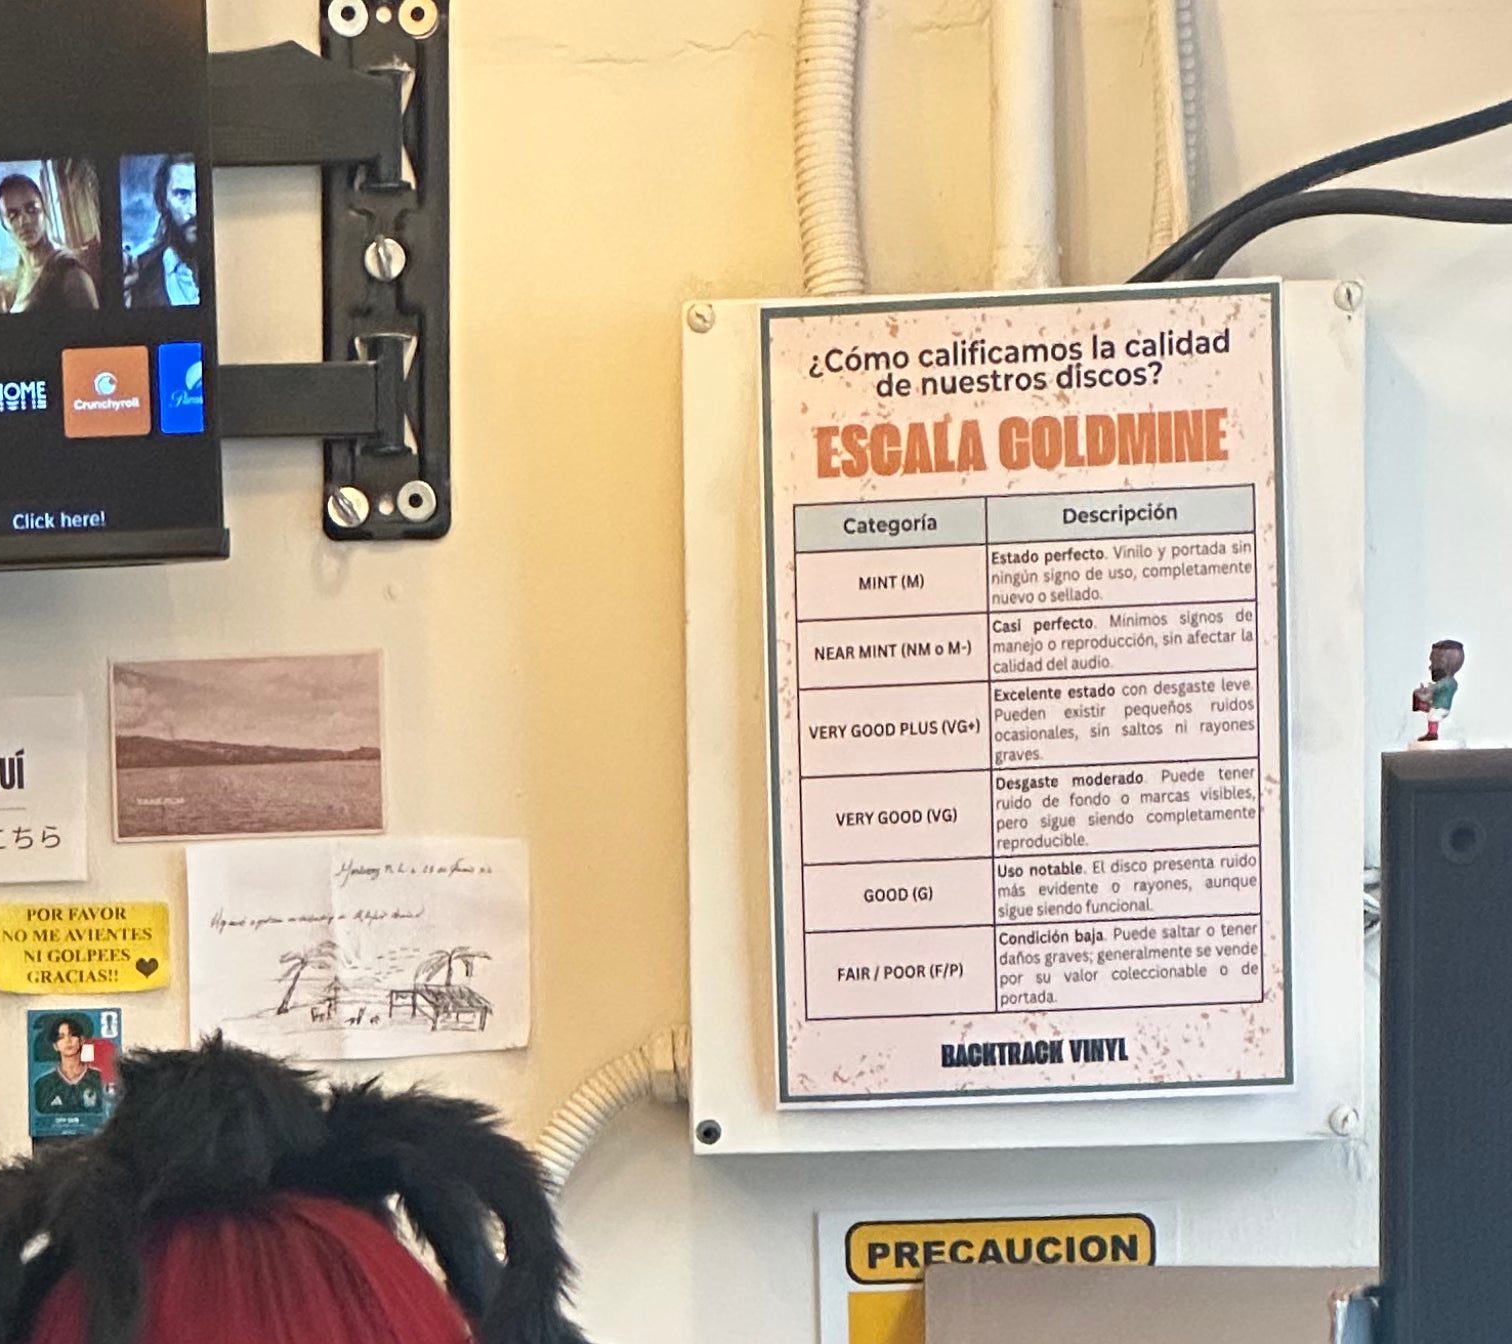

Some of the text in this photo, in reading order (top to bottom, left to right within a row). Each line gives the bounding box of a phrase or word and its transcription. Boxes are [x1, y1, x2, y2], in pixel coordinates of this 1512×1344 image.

[809, 328, 1231, 379] ¿Cómo calificamos la calidad
[876, 361, 1163, 398] de nuestros discos?
[74, 398, 139, 411] Crunchyroll
[816, 408, 1229, 479] ESCALA GOLDMINE
[13, 510, 105, 530] Click here!
[843, 513, 938, 537] Categoría
[1063, 504, 1178, 526] Descripción
[991, 541, 1252, 566] Estado perfecto. Vinilo y portada sin
[858, 574, 925, 590] MINT (M)
[814, 640, 972, 661] NEAR MINT (NM o M-)
[809, 718, 980, 739] VERY GOOD PLUS (VG+)
[836, 808, 957, 826] VERY GOOD (VG)
[864, 886, 933, 902] GOOD (G)
[27, 907, 126, 921] POR FAVOR
[2, 928, 152, 942] NO ME AVIENTES
[24, 949, 131, 962] NI GOLPEES
[27, 969, 118, 983] GRACIAS!!
[838, 967, 870, 981] FAIR
[884, 965, 926, 980] POOR
[930, 963, 963, 979] (F/P)
[941, 1038, 1128, 1067] BACKTRACK VINYL
[867, 1234, 1139, 1269] PRECAUCION
